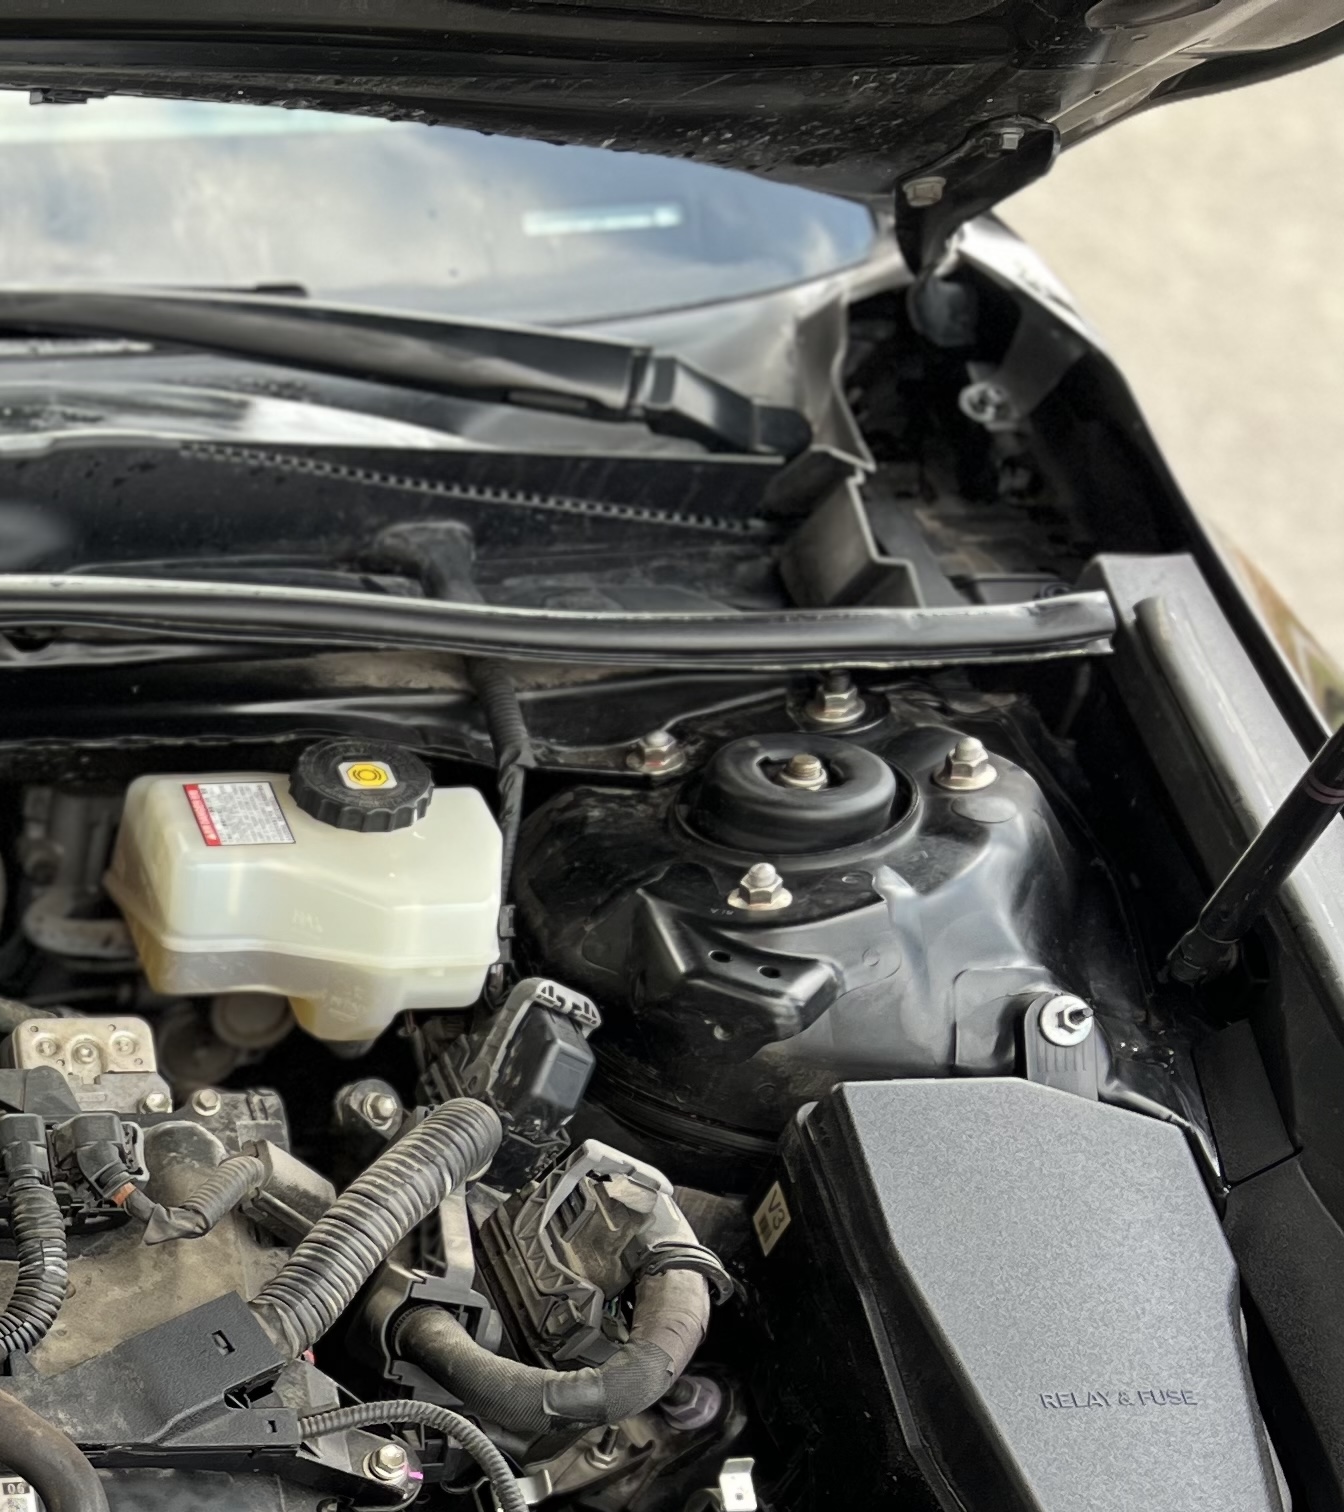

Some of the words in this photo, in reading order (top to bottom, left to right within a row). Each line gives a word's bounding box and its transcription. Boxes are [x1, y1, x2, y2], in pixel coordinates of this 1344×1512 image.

[1039, 1391, 1111, 1409] RELAY
[1118, 1391, 1134, 1406] &
[1137, 1389, 1198, 1406] FUSE
[7, 1482, 26, 1494] 06
